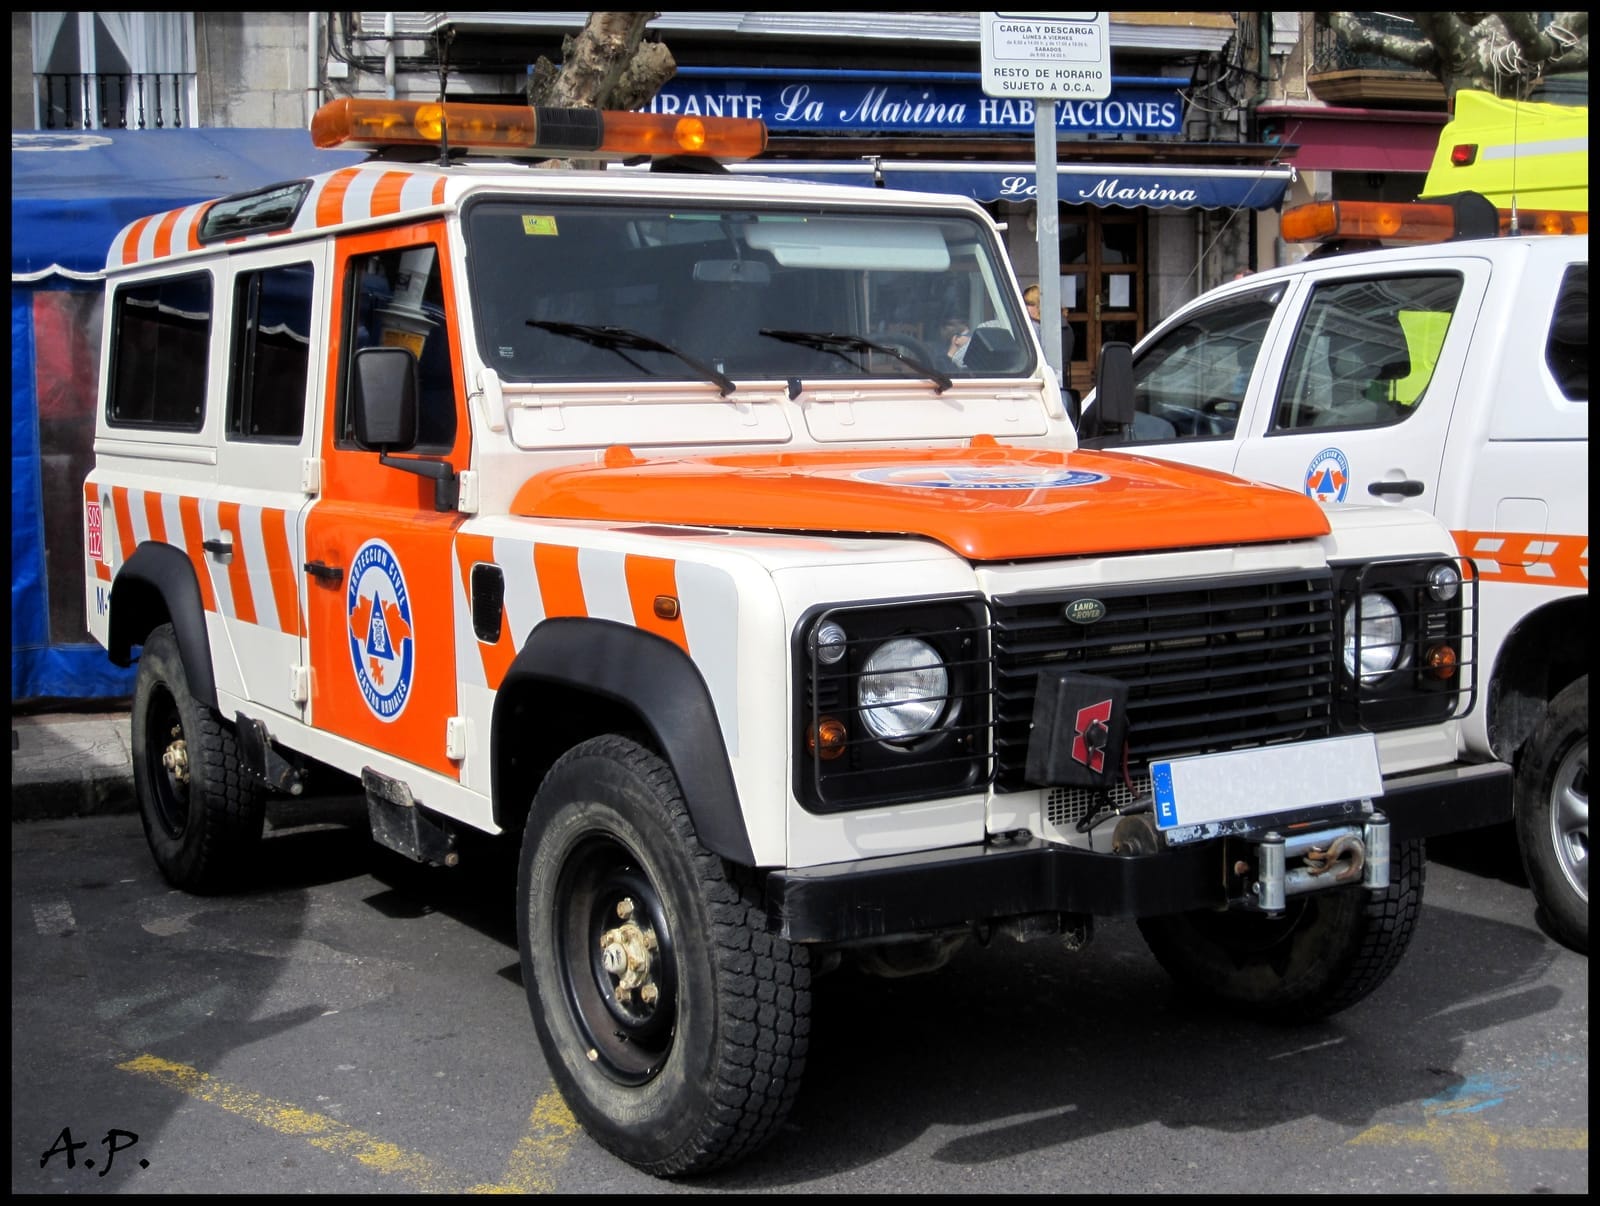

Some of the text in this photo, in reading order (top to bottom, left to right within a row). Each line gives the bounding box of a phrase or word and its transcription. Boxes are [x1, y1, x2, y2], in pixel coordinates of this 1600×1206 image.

[1000, 25, 1032, 33] CARGA
[1044, 26, 1094, 35] DESCARGA
[994, 68, 1103, 79] RESTO DE HORARIO
[1002, 81, 1095, 92] SUJETO A O.C.A.
[774, 84, 824, 122] La
[839, 86, 967, 124] Marina
[979, 99, 1176, 127] HABACIONES
[1079, 178, 1197, 201] Marina
[88, 506, 100, 528] SOS
[89, 532, 101, 555] 112
[389, 562, 405, 606] CIVIL
[1074, 602, 1094, 611] LAND
[1076, 609, 1101, 619] ROVER
[1161, 802, 1172, 817] E
